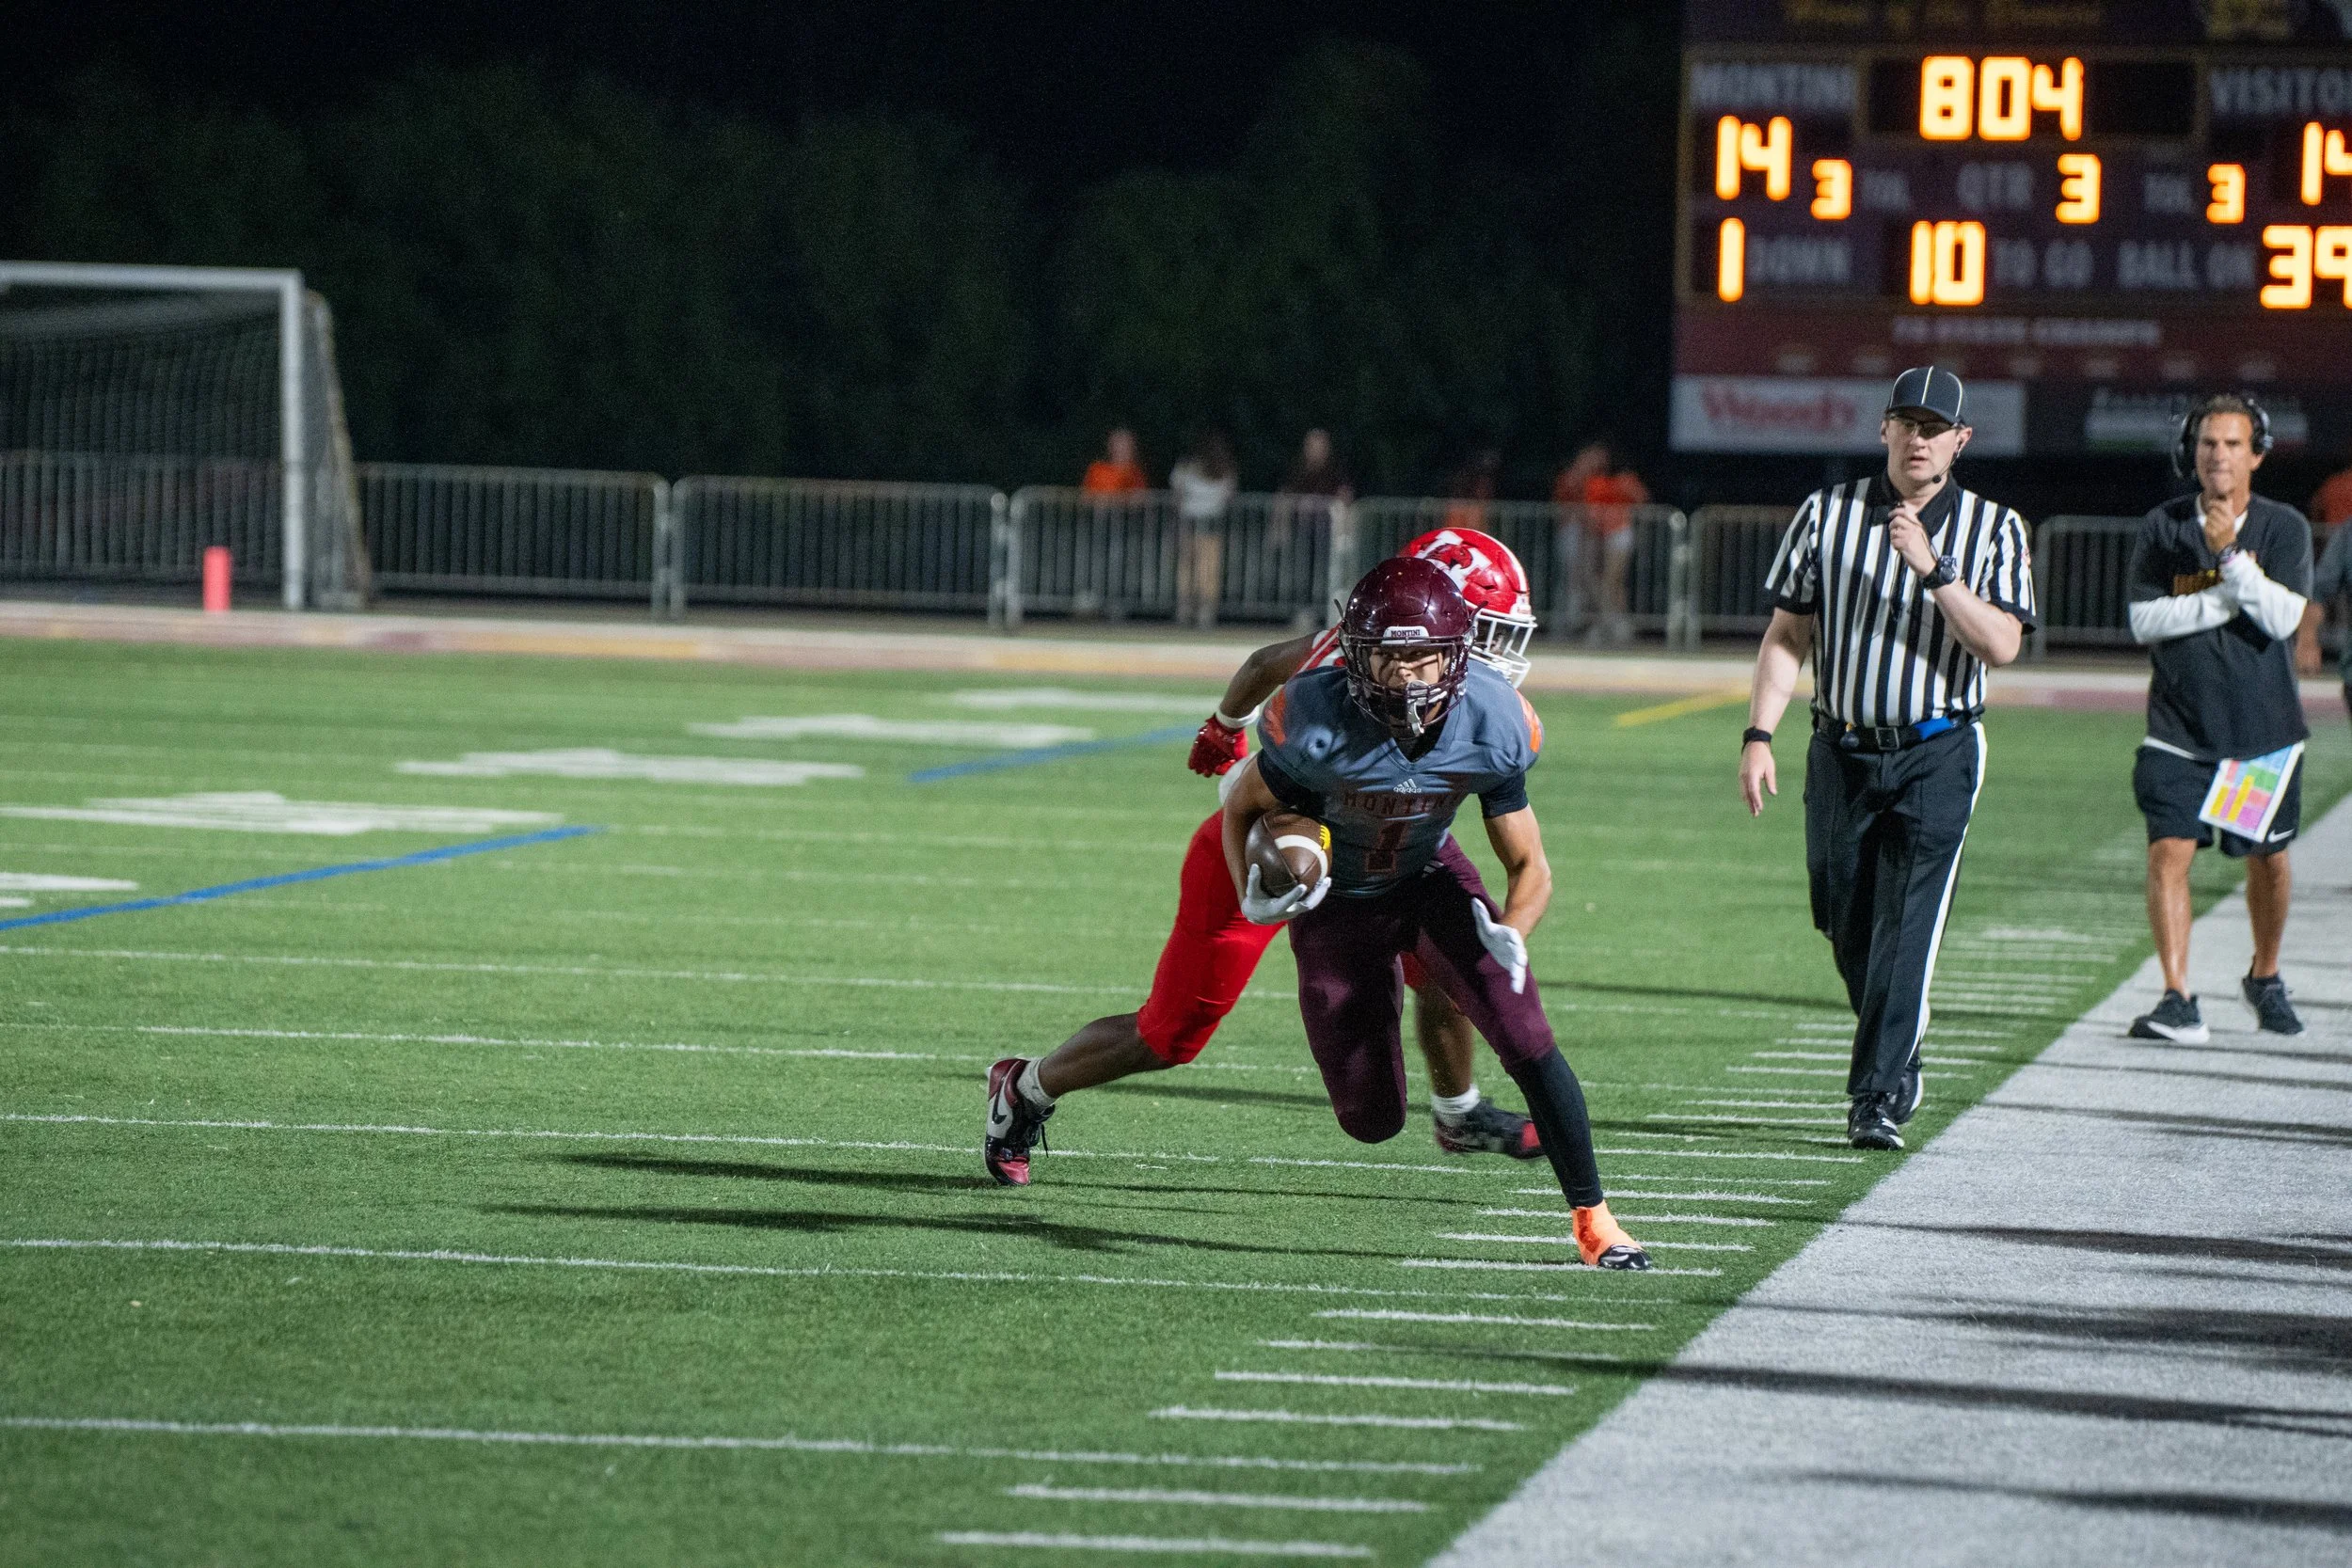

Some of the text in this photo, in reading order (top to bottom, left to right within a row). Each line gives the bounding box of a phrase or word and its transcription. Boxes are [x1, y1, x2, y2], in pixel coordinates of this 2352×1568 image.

[2209, 67, 2352, 114] VISITO
[1715, 115, 1792, 201] 14
[1810, 158, 1852, 220] 3
[2055, 153, 2102, 224] 3
[2205, 164, 2247, 224] 3
[1718, 217, 1745, 303] 1
[1910, 220, 1987, 306] 10
[2260, 225, 2352, 309] 39
